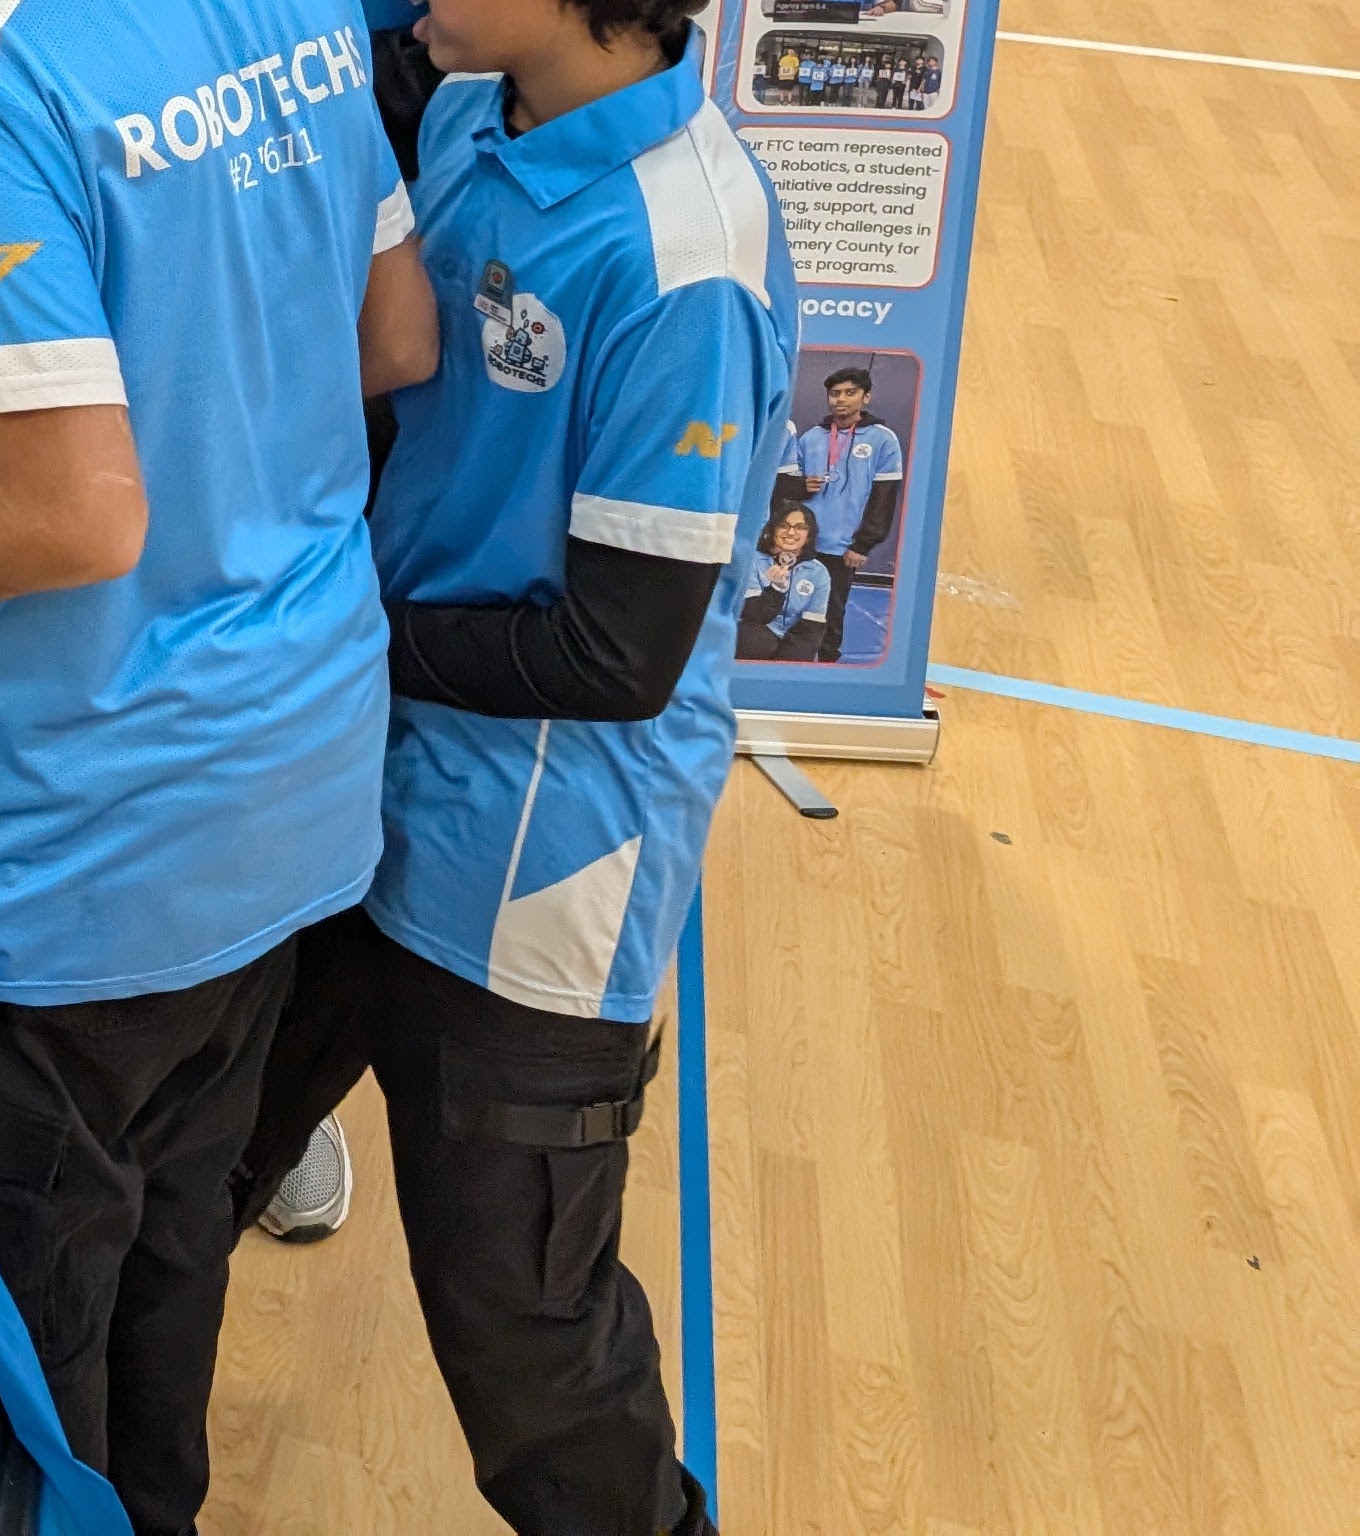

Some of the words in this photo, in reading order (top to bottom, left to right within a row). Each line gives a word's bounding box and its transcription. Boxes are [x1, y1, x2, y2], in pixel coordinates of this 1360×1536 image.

[115, 25, 366, 179] ROBOTECHS
[767, 140, 794, 152] FTC
[799, 141, 839, 152] team
[844, 141, 942, 157] represented
[229, 128, 322, 193] #2611
[782, 160, 849, 174] Robotics,
[855, 164, 865, 172] a
[869, 162, 939, 176] student-
[773, 180, 832, 192] nitiative
[837, 182, 927, 199] addressing
[813, 202, 877, 215] support,
[882, 204, 914, 215] and
[825, 221, 913, 237] challenges
[917, 224, 930, 236] in
[836, 240, 893, 256] County
[898, 243, 919, 255] for
[816, 260, 897, 274] programs.
